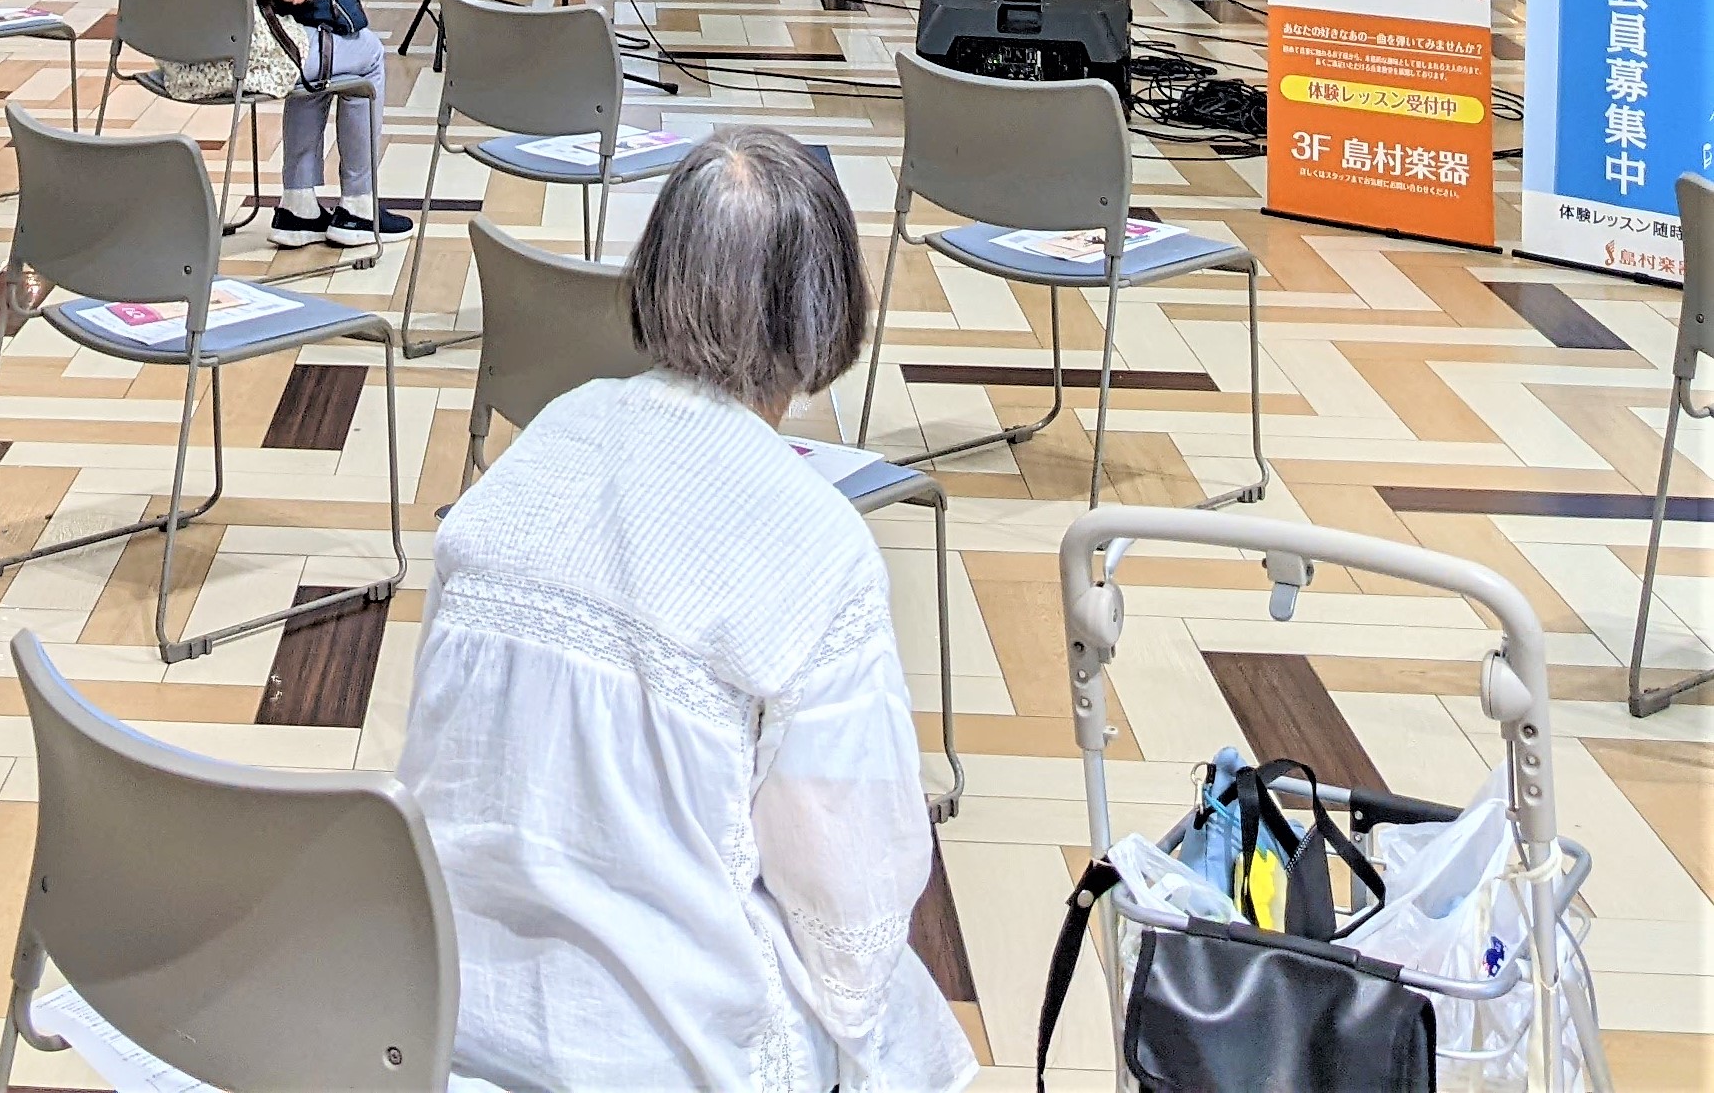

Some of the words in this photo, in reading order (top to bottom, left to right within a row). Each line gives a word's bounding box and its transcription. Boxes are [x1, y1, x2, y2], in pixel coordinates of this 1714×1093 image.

[1307, 81, 1458, 117] 体験レッスン受付中
[1290, 130, 1332, 162] 3F
[1341, 137, 1470, 186] 島村楽器
